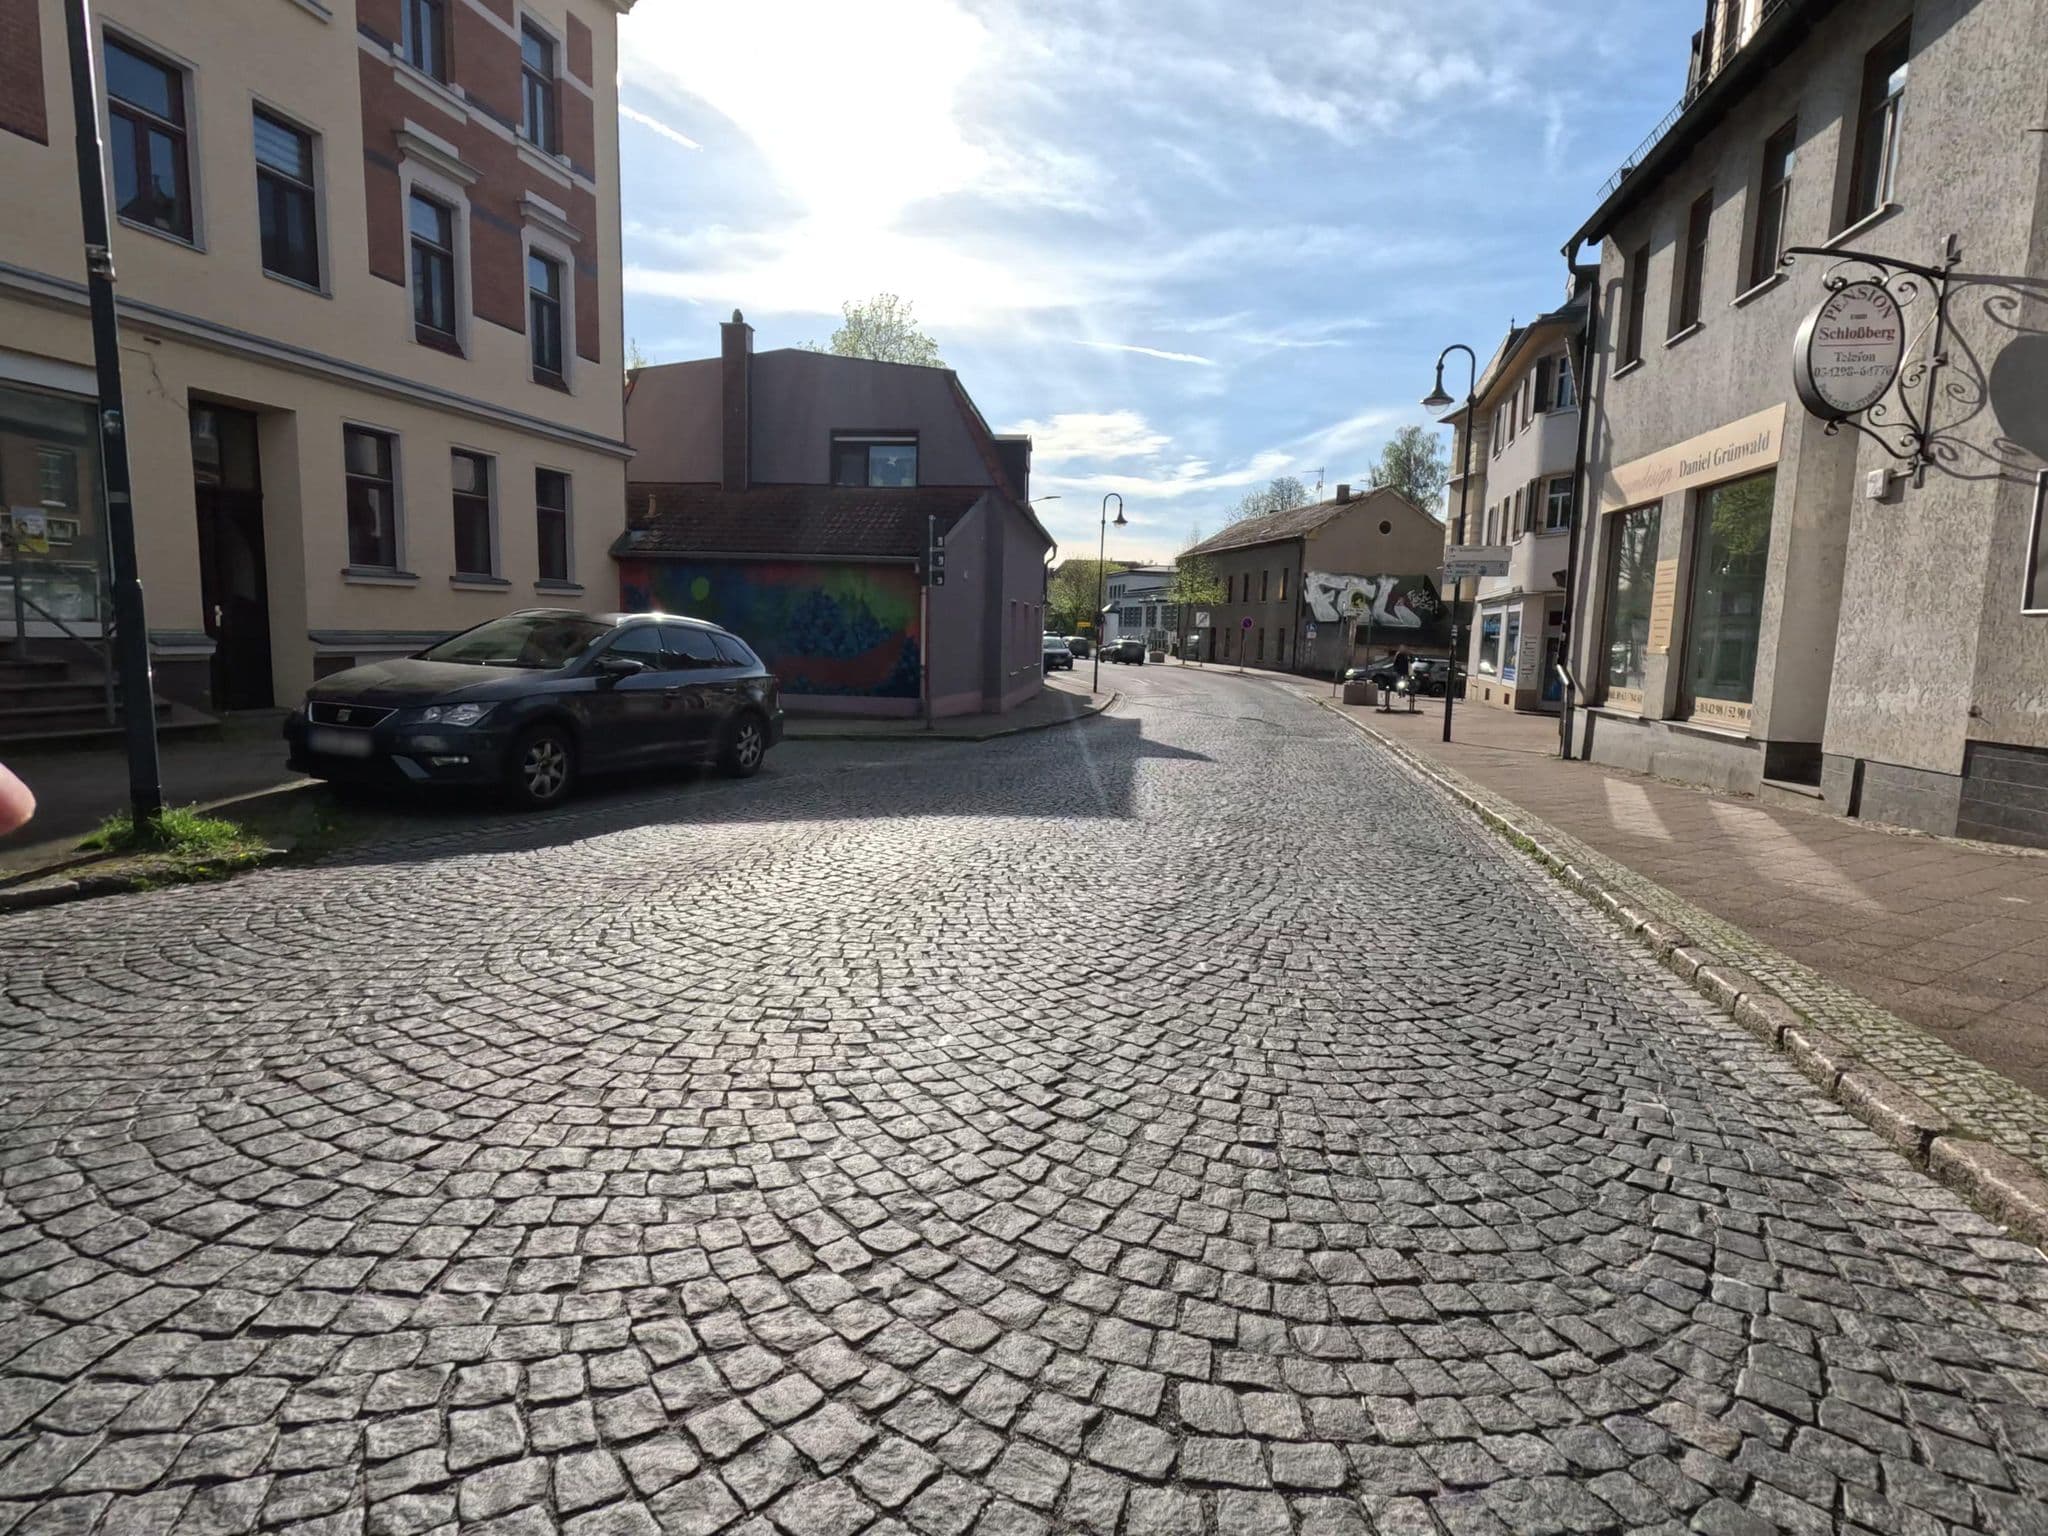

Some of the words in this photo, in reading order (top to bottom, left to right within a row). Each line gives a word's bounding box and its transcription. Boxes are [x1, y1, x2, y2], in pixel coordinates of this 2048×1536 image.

[1823, 286, 1897, 321] PENSION
[1818, 326, 1896, 341] Schloßberg
[1679, 451, 1711, 478] Daniel
[1713, 430, 1771, 467] Grünwald
